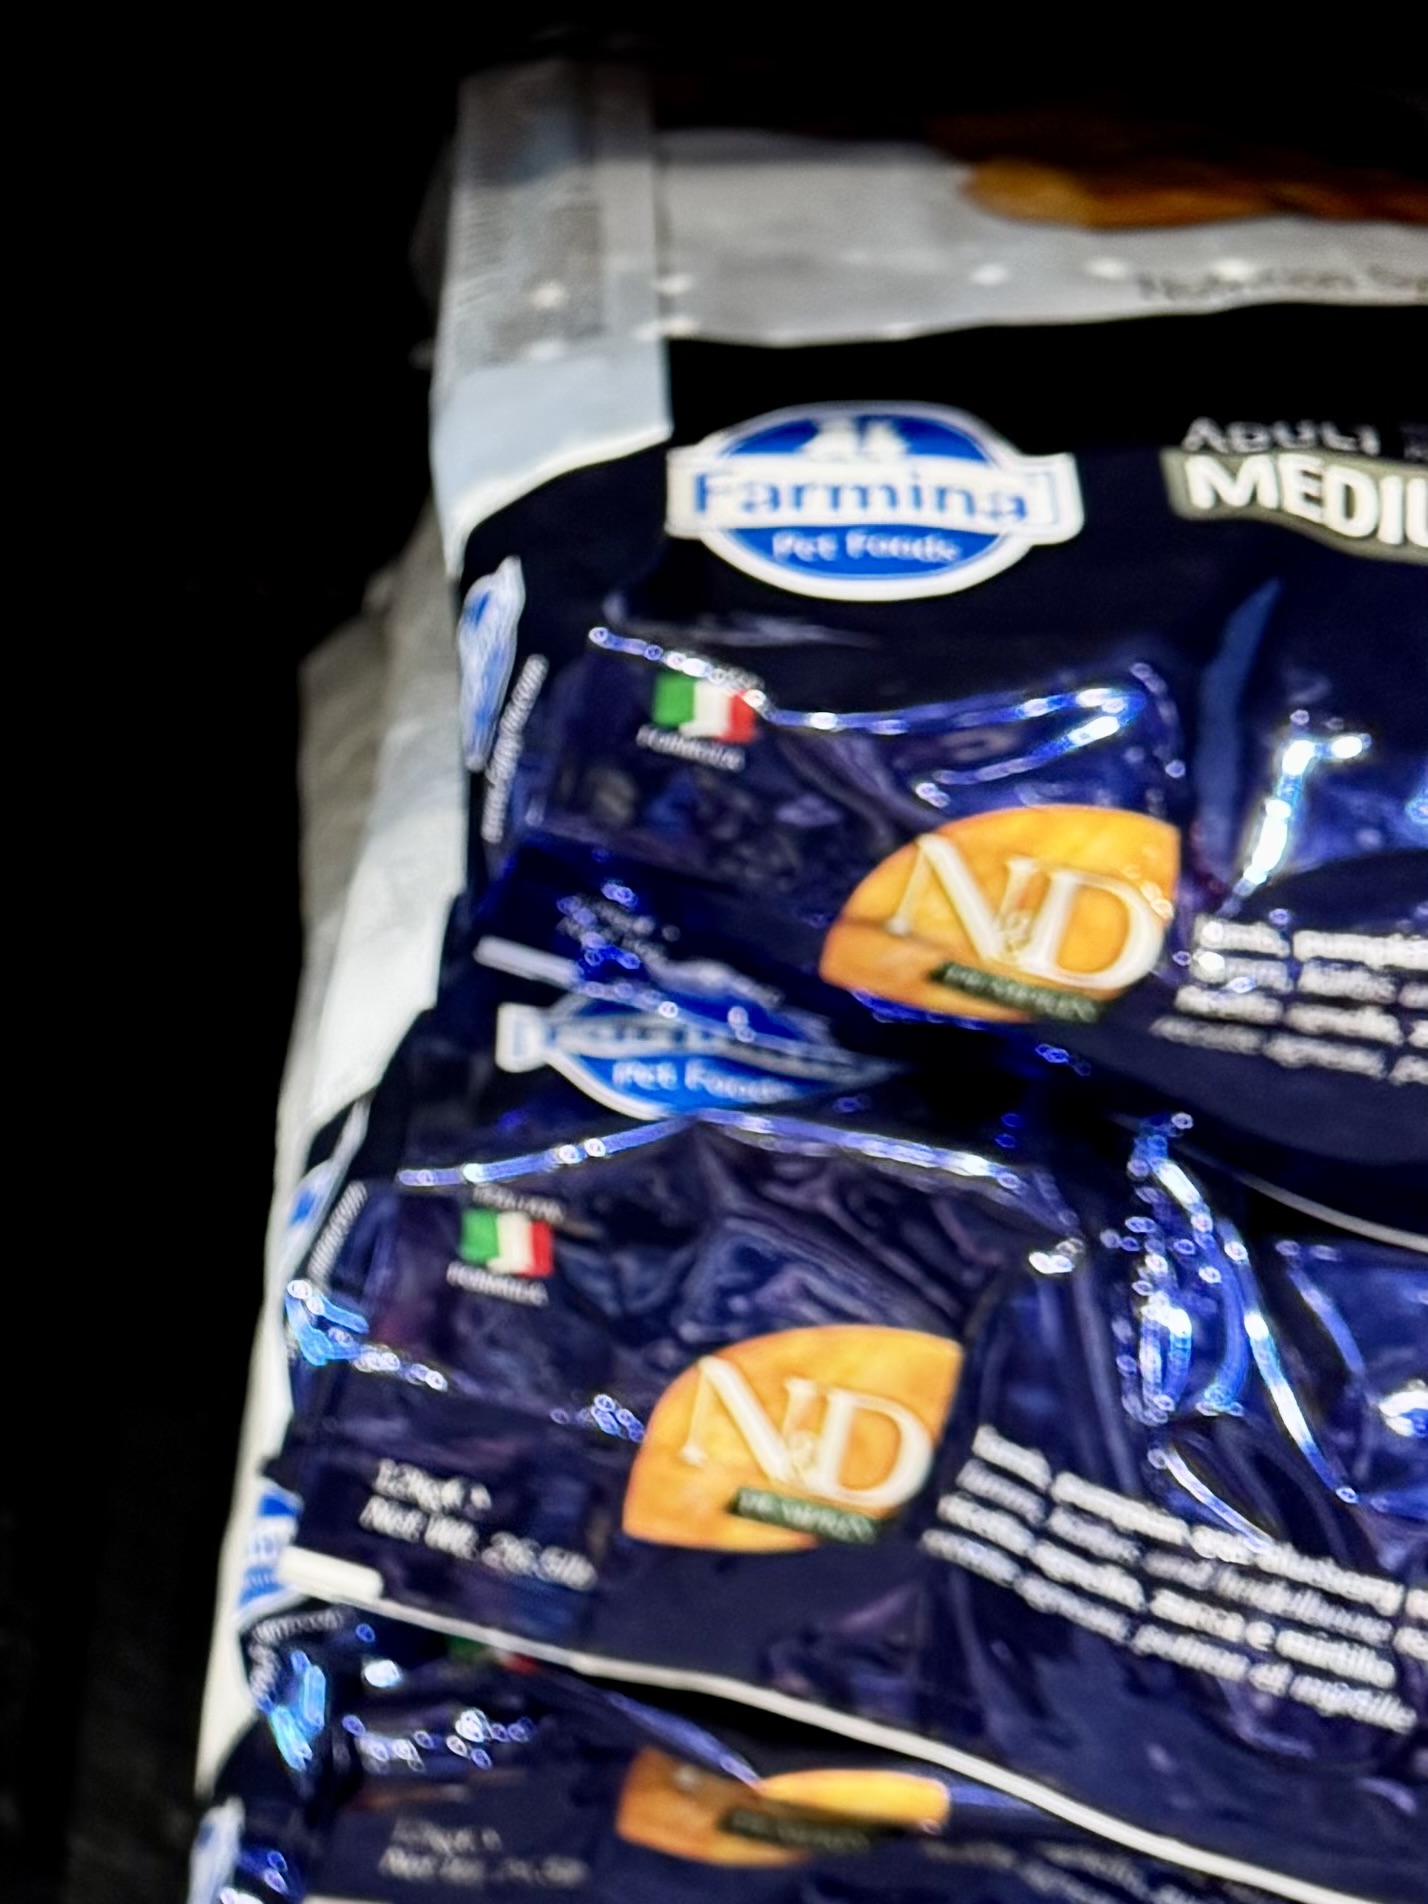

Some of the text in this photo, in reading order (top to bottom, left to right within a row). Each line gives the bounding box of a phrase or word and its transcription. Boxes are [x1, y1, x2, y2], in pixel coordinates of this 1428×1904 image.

[691, 463, 1028, 528] Farmina
[773, 530, 960, 564] Pet Foods
